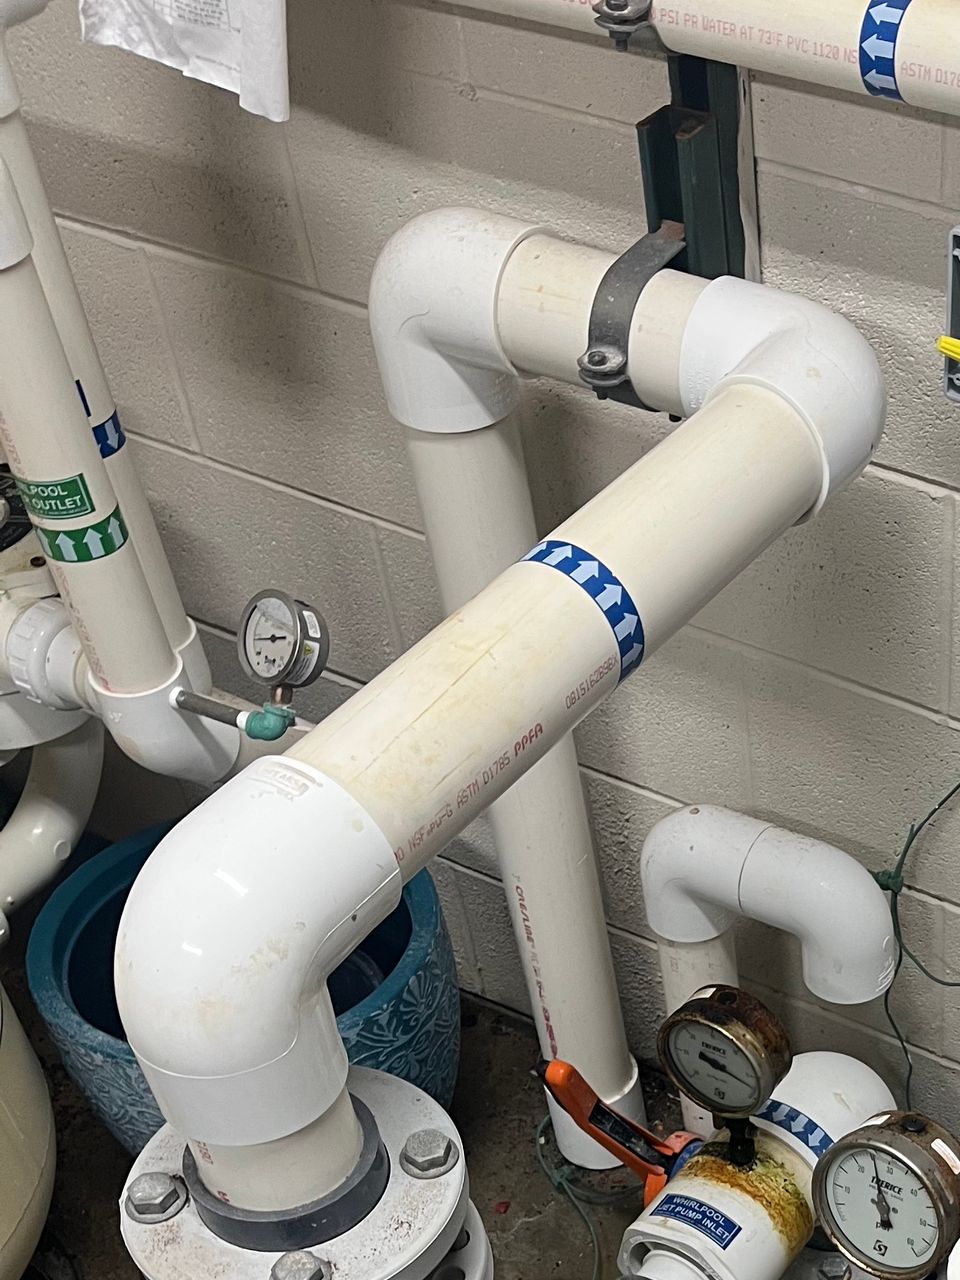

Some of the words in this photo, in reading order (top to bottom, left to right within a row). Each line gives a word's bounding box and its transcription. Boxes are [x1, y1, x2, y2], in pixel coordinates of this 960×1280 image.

[659, 10, 680, 26] PSI
[684, 13, 698, 29] PR
[702, 17, 737, 40] WATER
[740, 25, 754, 39] AT
[787, 37, 809, 54] PVC
[812, 41, 840, 60] 1120
[843, 47, 858, 65] NS
[900, 62, 932, 82] ASTM
[32, 495, 81, 510] OUTLET
[456, 779, 481, 809] ASTM
[482, 752, 511, 785] D1785
[513, 722, 544, 757] PPFA
[673, 1197, 725, 1226] WHIRLPOOL
[675, 1206, 703, 1220] PUMP
[702, 1217, 730, 1239] INLET
[875, 1221, 891, 1232] pi
